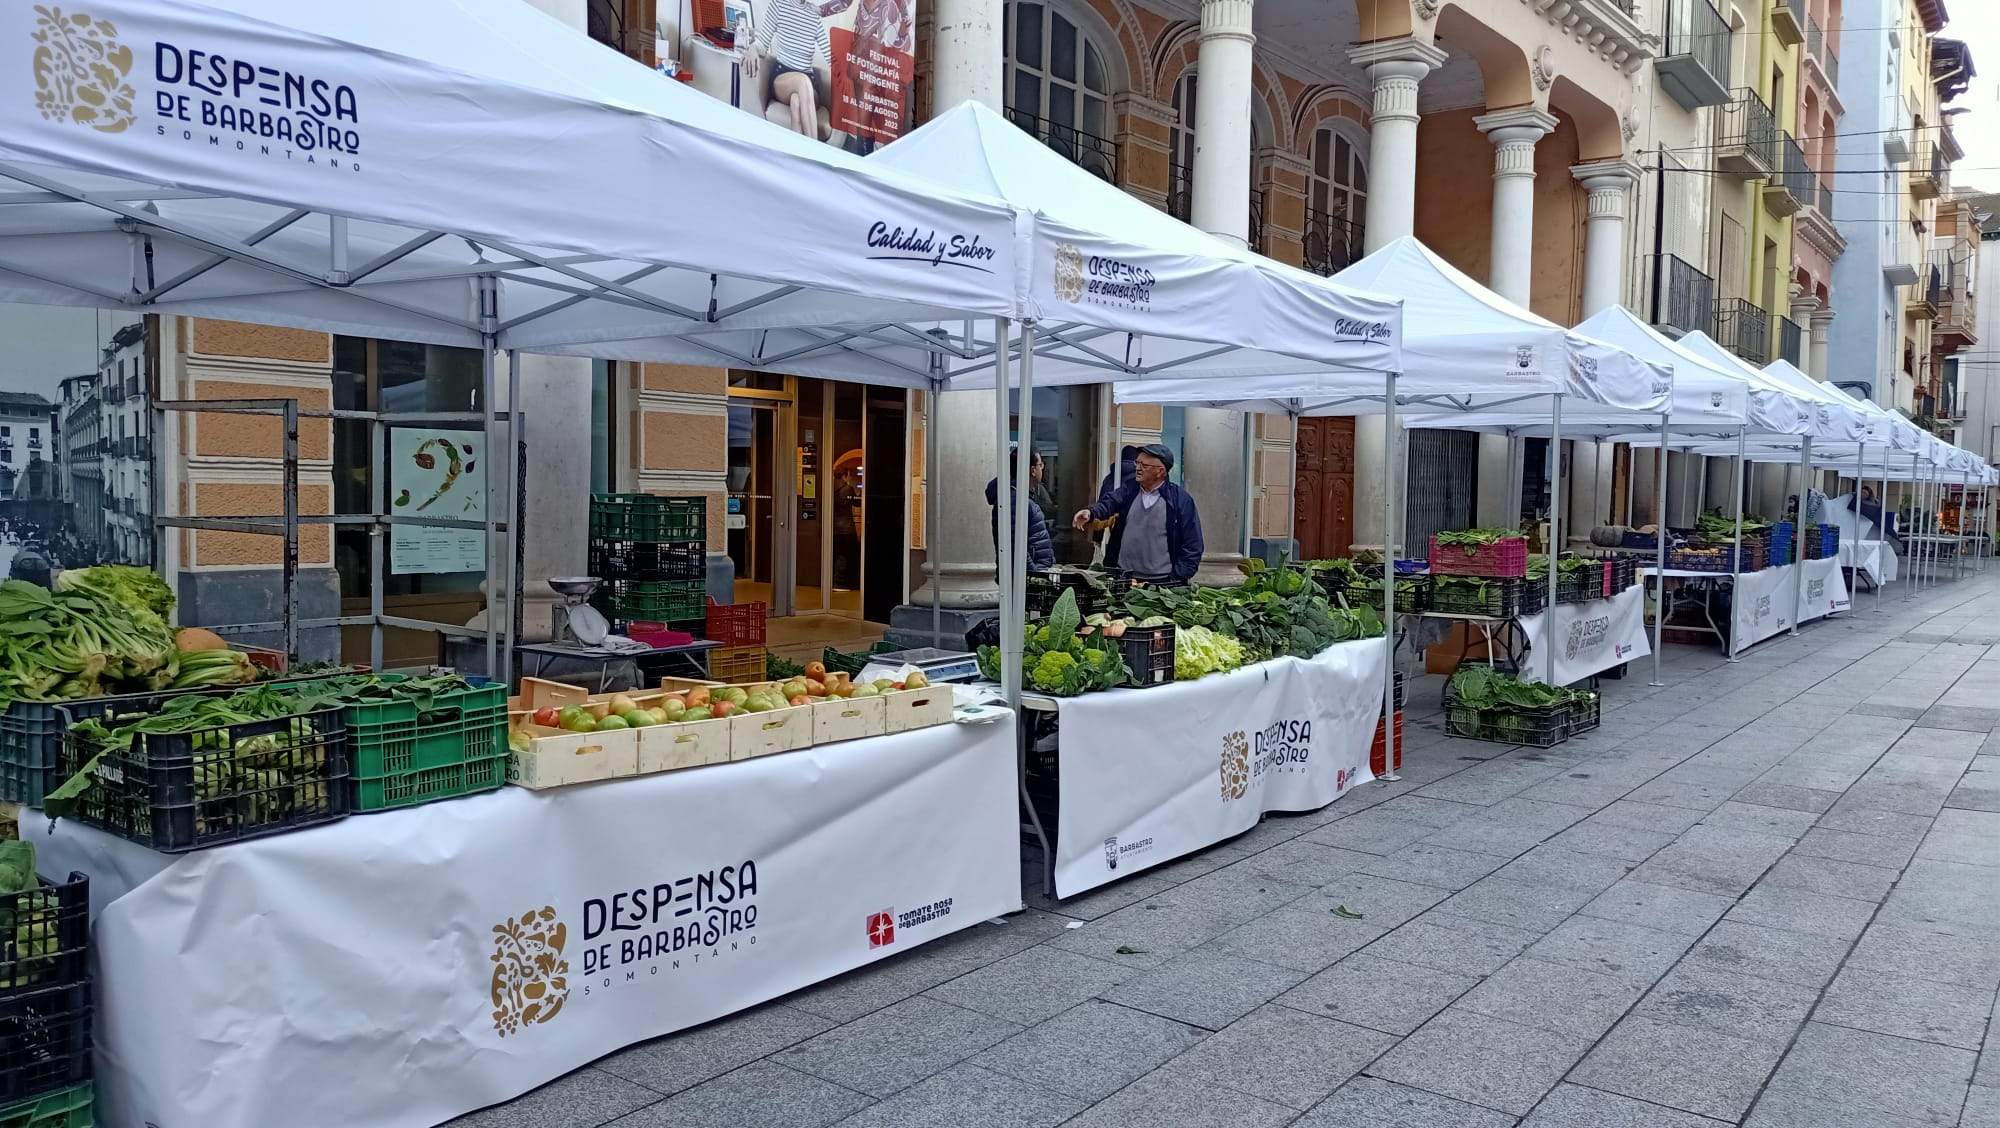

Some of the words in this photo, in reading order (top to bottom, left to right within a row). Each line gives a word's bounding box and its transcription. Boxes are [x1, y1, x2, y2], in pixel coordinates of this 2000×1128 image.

[846, 53, 856, 63] DE
[857, 57, 899, 80] FOTOGRAFÍA
[870, 50, 900, 68] FESTIVAL
[155, 41, 358, 124] DESPENSA
[860, 71, 899, 92] EMERGENTE
[850, 98, 858, 107] AL
[865, 104, 873, 112] DE
[874, 107, 898, 119] AGOSTO
[863, 92, 898, 109] BARBASTRO
[157, 91, 191, 121] DE
[202, 101, 360, 155] BARBASTRO
[884, 119, 898, 129] 2022
[157, 125, 360, 172] SOMONTANO
[867, 221, 935, 253] Calidad
[933, 242, 946, 267] y
[948, 234, 995, 260] Sabor
[1089, 256, 1155, 287] DESPENSA
[1088, 280, 1101, 293] DE
[1101, 282, 1150, 303] BARBASTRO
[1255, 720, 1311, 756] DESPENSA
[1262, 742, 1309, 772] BASTRO
[583, 859, 757, 940] DESPENSA
[583, 944, 611, 976] DE
[621, 905, 757, 966] BARBASTRO
[584, 936, 757, 996] SOMONTANO
